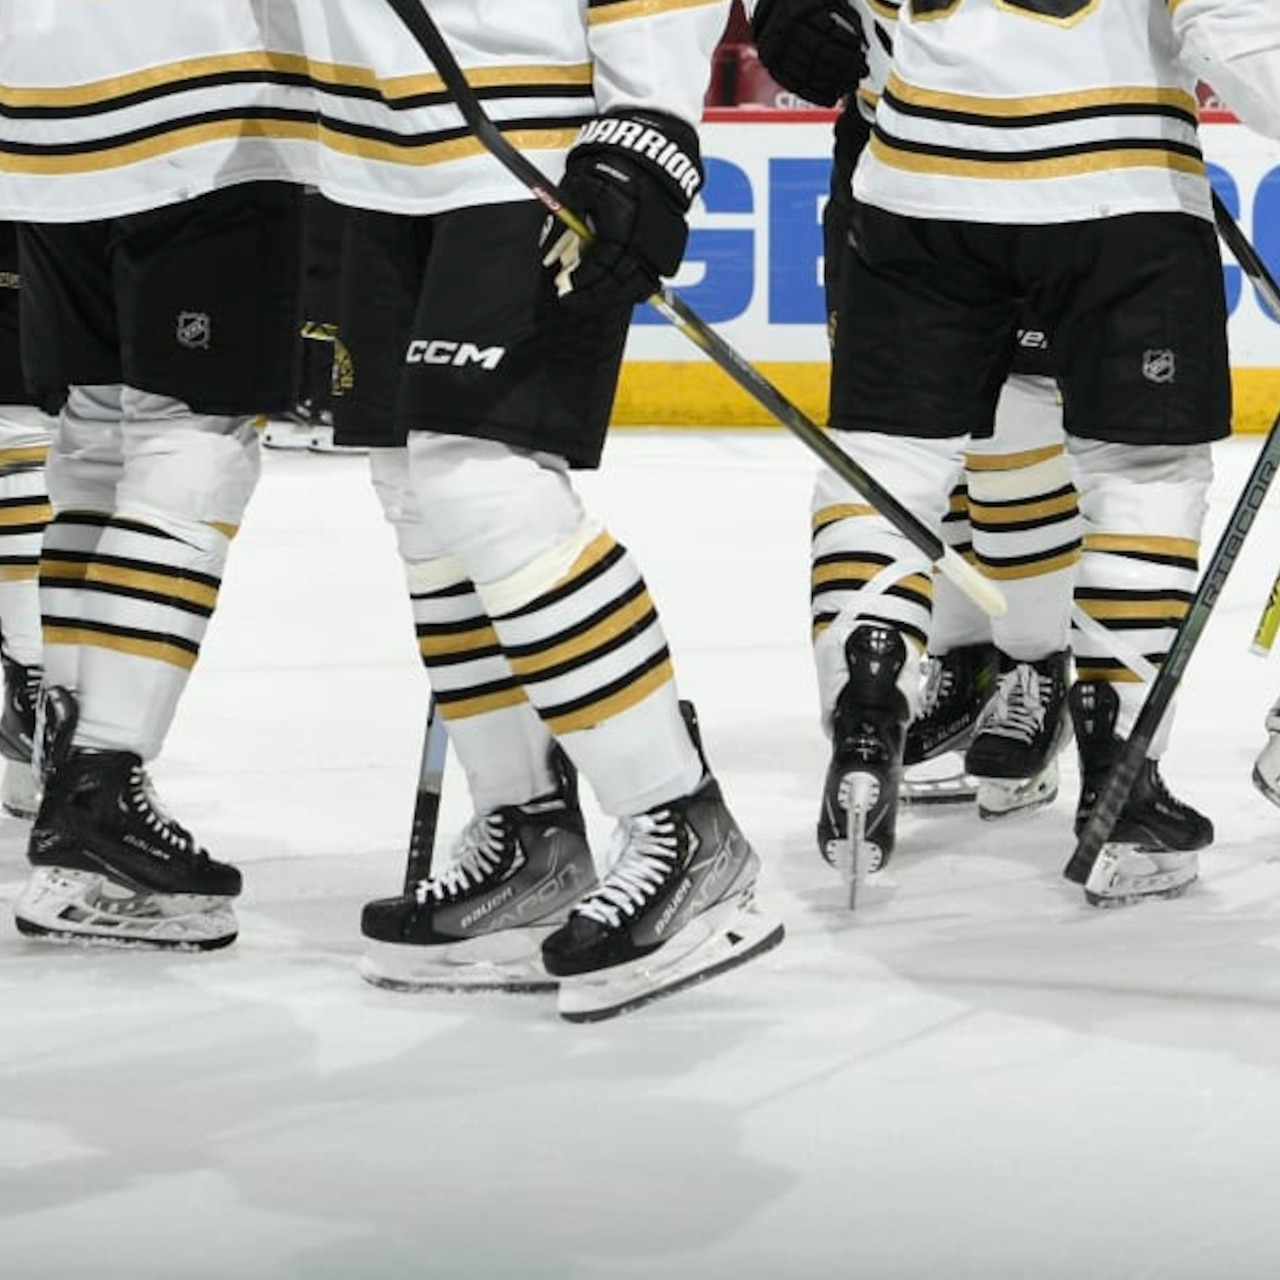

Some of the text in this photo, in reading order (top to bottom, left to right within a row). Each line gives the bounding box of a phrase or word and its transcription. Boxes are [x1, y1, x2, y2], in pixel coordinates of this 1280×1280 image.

[577, 118, 701, 198] WARRIOR
[406, 339, 505, 370] CCM
[1202, 459, 1277, 609] RIBCOR
[461, 886, 513, 928] BAUER
